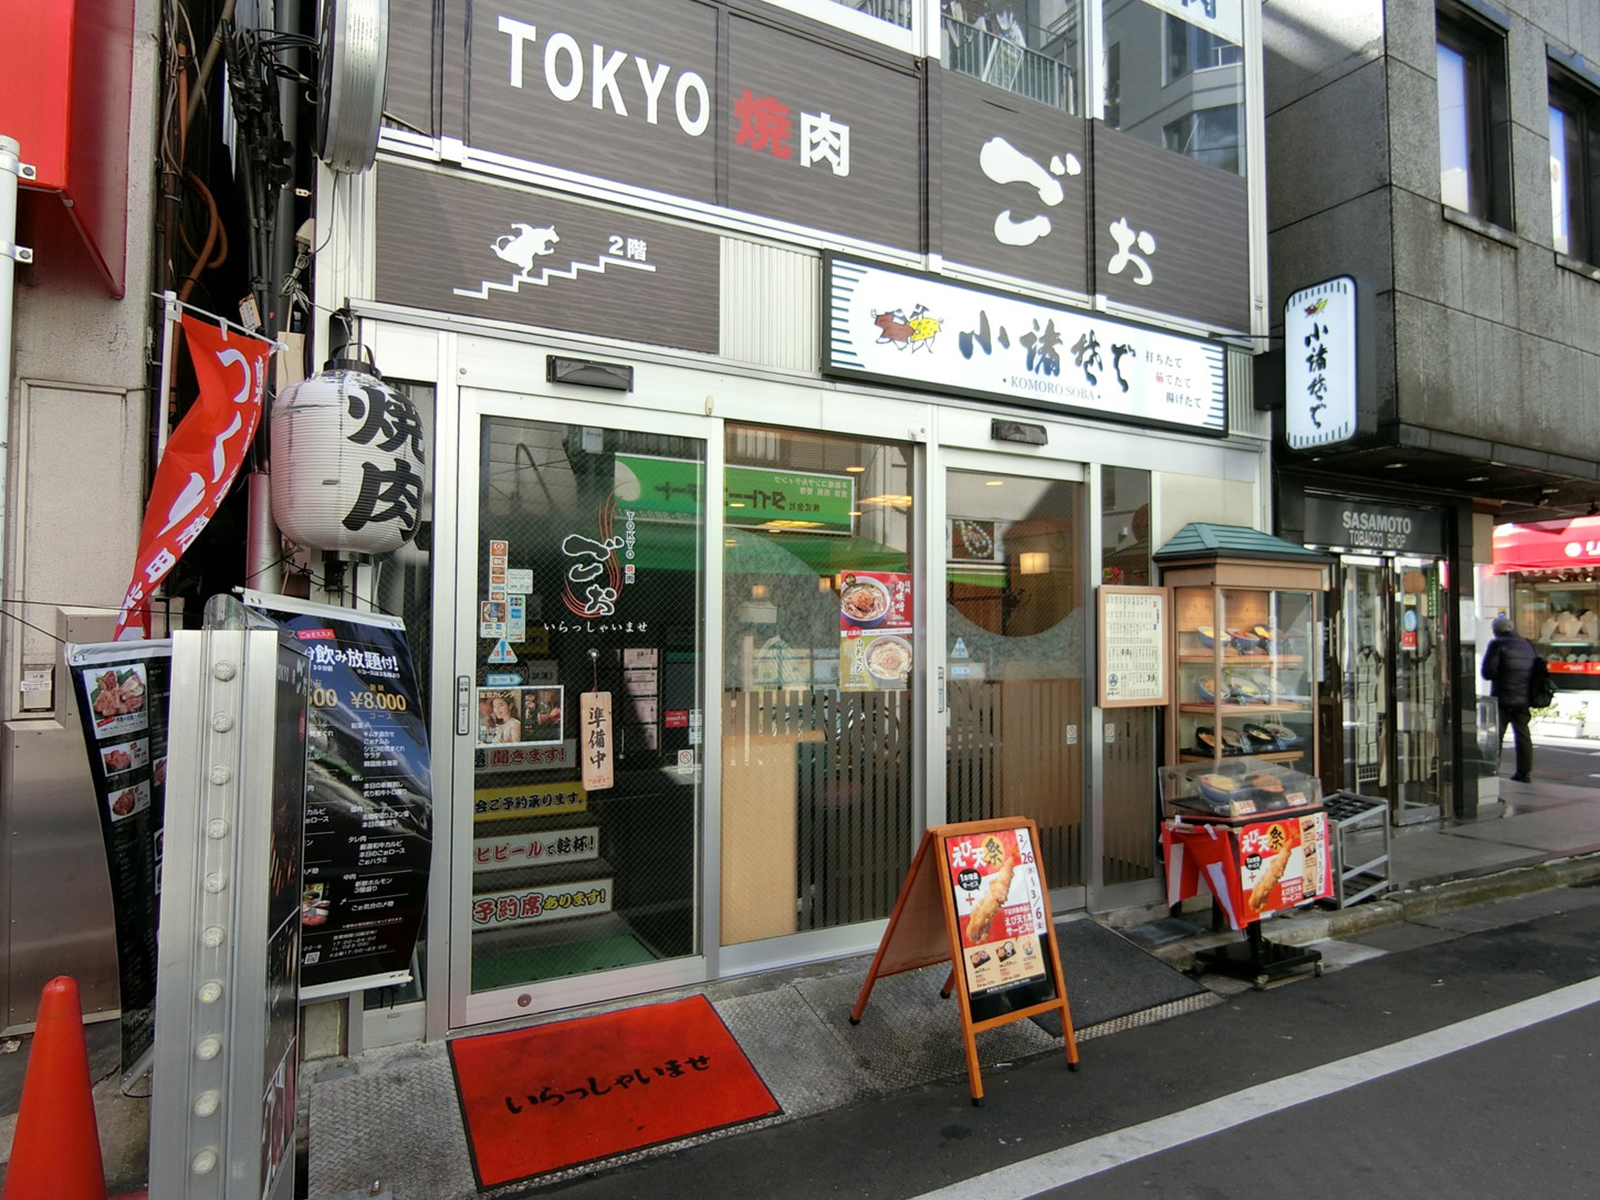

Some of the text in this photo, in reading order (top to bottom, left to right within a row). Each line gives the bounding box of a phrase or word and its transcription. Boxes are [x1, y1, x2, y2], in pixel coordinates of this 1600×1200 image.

[498, 16, 711, 137] TOKYO
[734, 89, 850, 177] 焼肉
[609, 236, 647, 261] 2階
[1146, 350, 1182, 368] 打ちたて
[1011, 376, 1094, 401] KOMORO SOBA
[1166, 391, 1202, 409] 揚げたて
[342, 385, 426, 541] 焼肉
[1342, 510, 1412, 534] SASAMOTO
[625, 511, 636, 584] TOKYO 焼肉
[1349, 529, 1406, 549] TOBACCO SHOP
[543, 620, 648, 633] いらっしゃいませ
[350, 690, 407, 711] ¥8,000
[369, 712, 393, 720] コース
[587, 707, 607, 769] 準備中
[1242, 825, 1284, 853] えび天 祭
[952, 838, 1003, 868] えび天 祭
[504, 1054, 711, 1115] いらっしゃいませ
